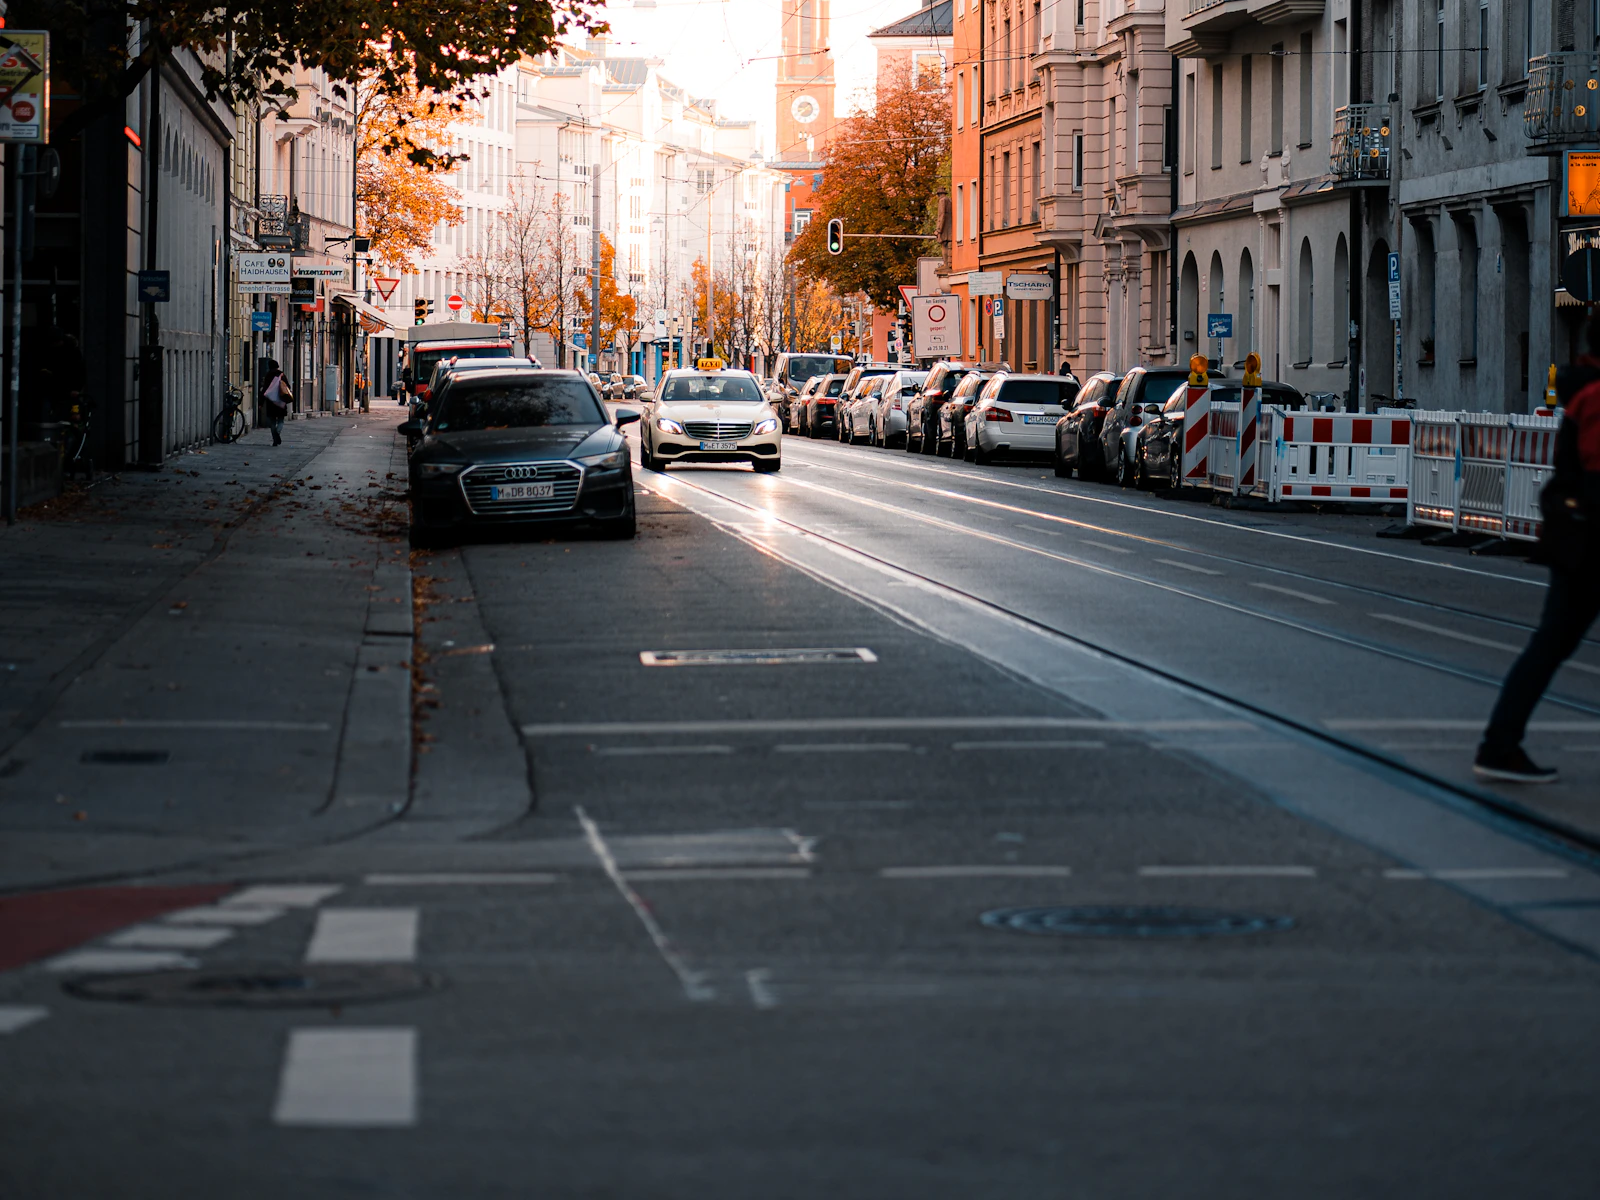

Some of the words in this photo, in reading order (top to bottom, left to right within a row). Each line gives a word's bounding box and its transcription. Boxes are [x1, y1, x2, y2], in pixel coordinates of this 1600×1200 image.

[241, 267, 289, 275] HAIDHAUSEN
[293, 268, 343, 276] vinzenzmurr
[239, 284, 291, 292] Innenhof-Terrasse
[497, 487, 504, 498] M
[511, 486, 525, 498] DB
